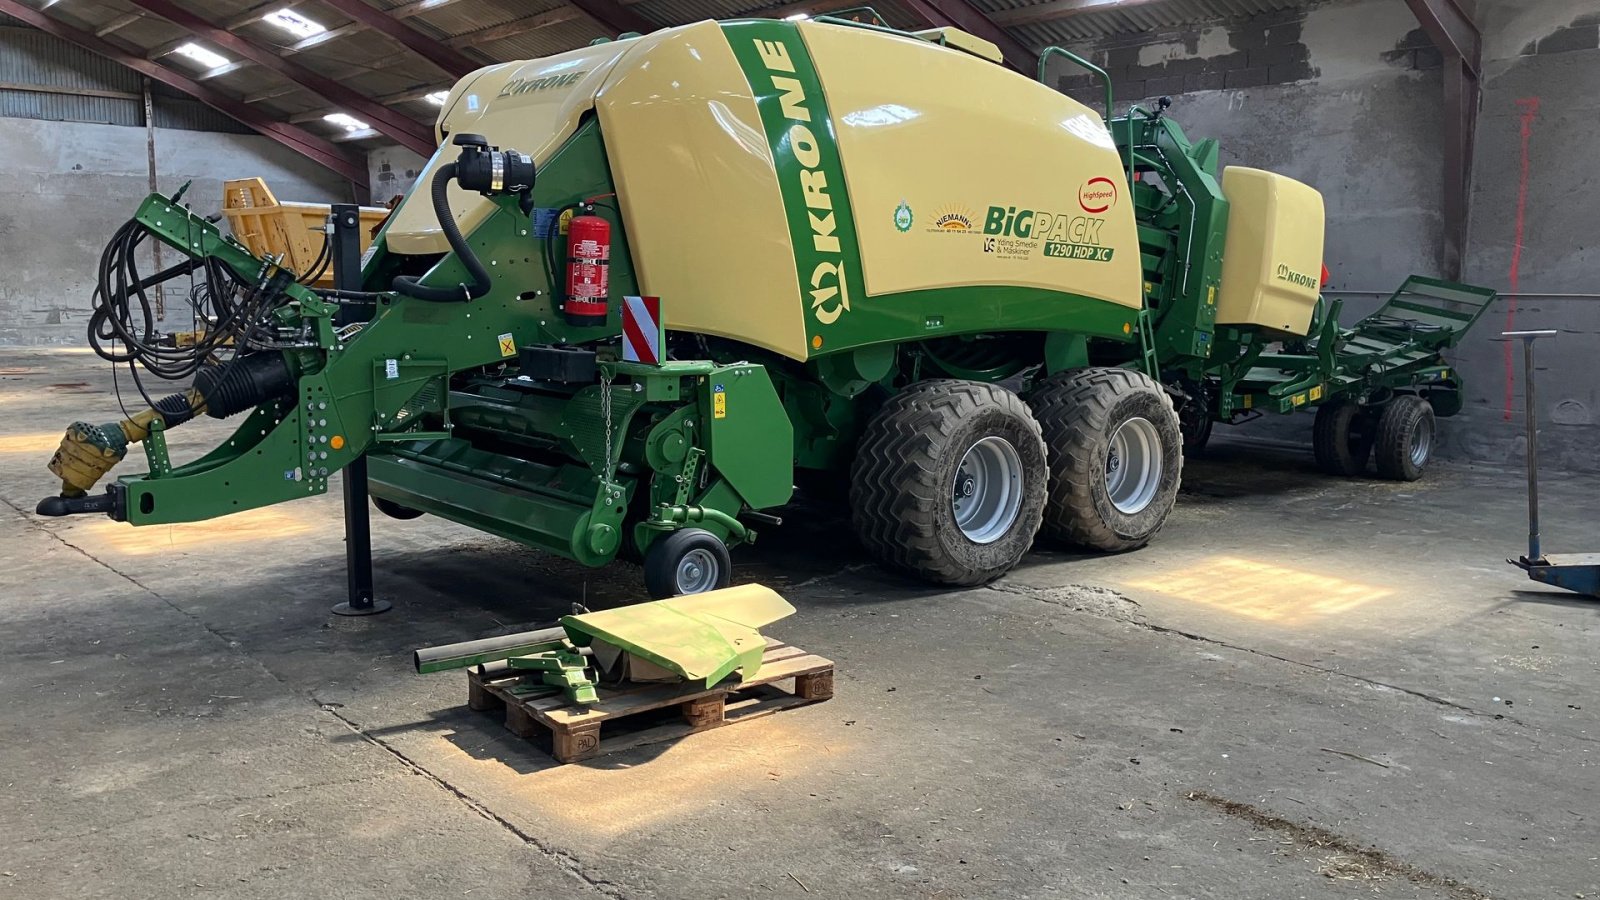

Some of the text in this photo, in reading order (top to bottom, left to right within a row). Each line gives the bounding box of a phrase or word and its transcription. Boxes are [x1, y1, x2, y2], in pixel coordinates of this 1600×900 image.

[753, 38, 841, 253] KRONE
[1083, 191, 1113, 200] HighSpeed
[997, 239, 1038, 249] Yding Smedie
[1049, 243, 1110, 260] 1290 HDP XC
[1287, 271, 1317, 289] KRONE
